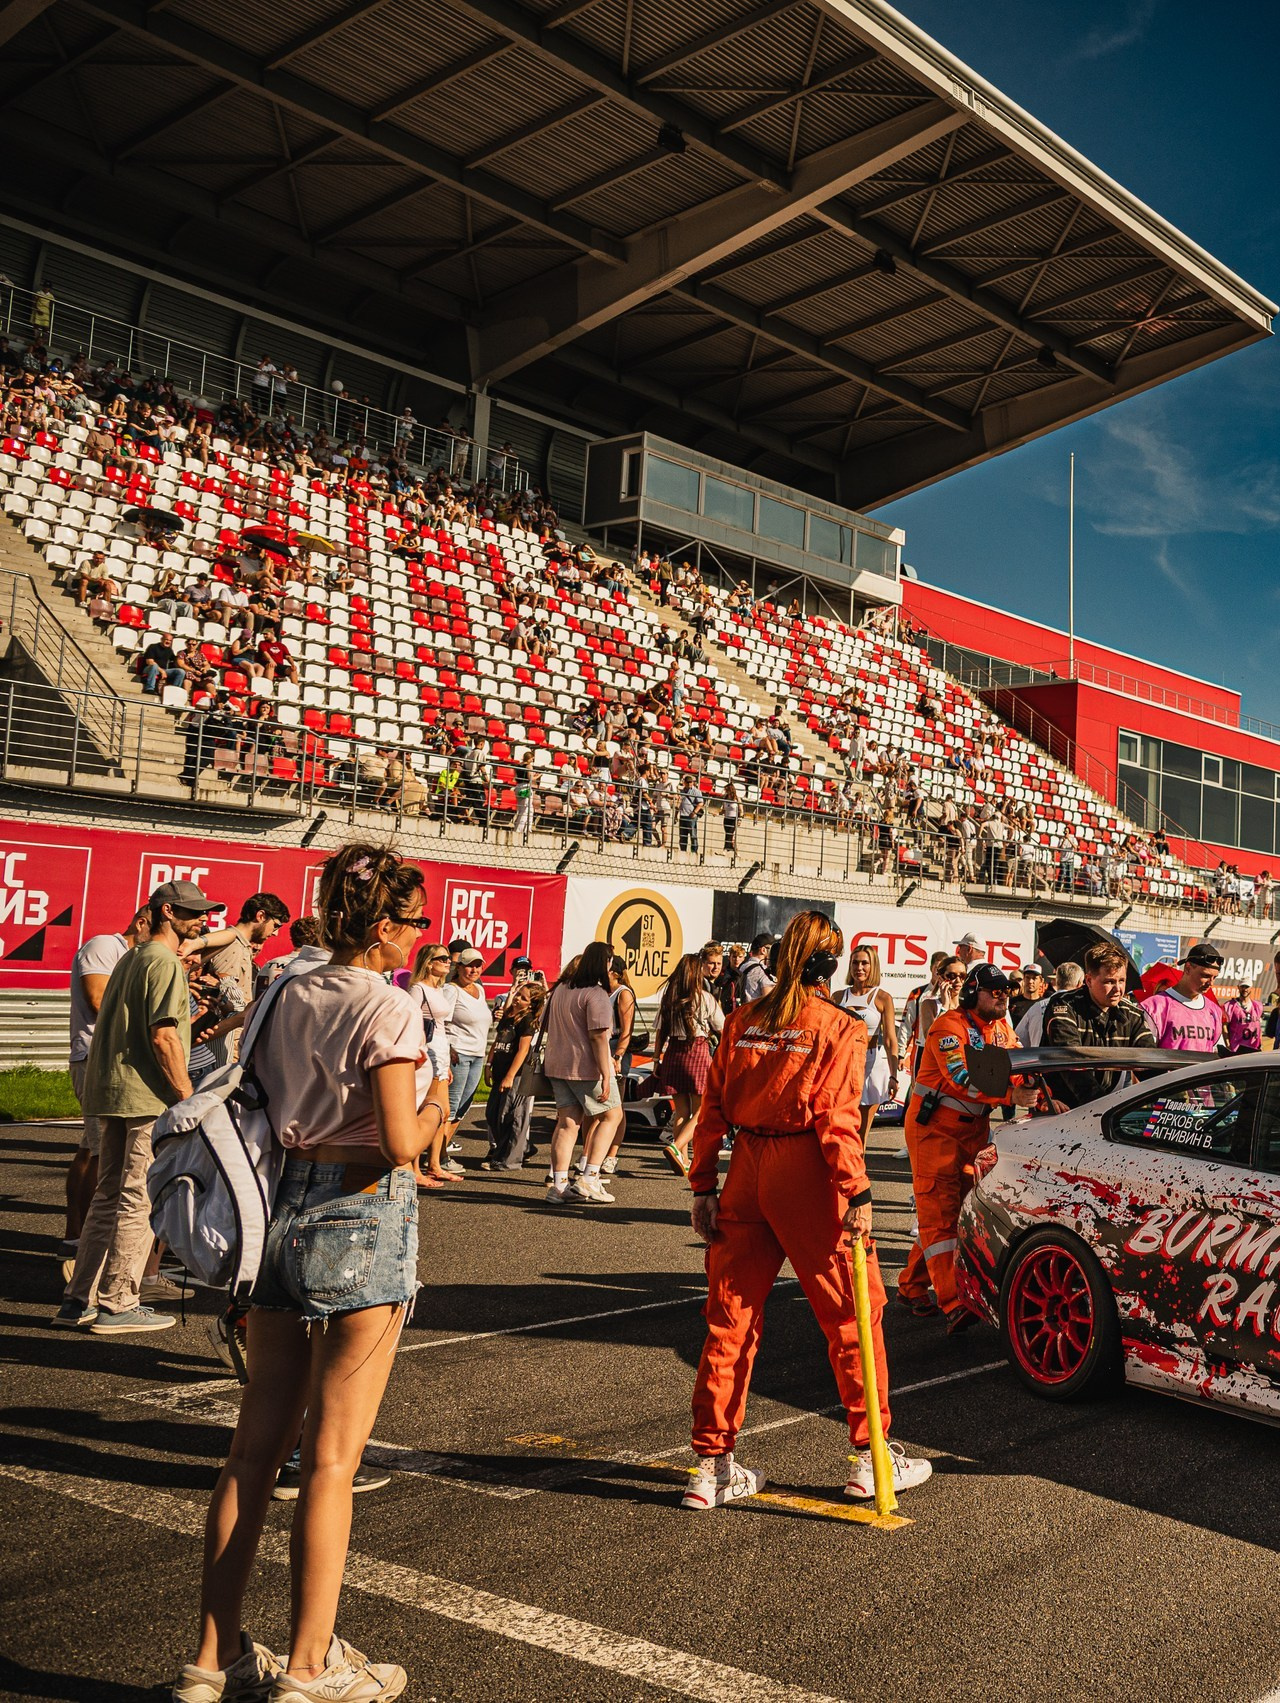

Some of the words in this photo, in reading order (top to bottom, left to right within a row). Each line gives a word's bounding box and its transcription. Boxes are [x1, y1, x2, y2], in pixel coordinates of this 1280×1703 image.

[450, 888, 495, 919] РГС
[448, 917, 509, 949] ЖИЗ
[625, 948, 671, 978] PLACE
[735, 1040, 779, 1052] Marshals
[785, 1044, 812, 1054] Team
[1156, 1112, 1194, 1130] ЯРКОВ
[1194, 1118, 1205, 1132] С.
[1150, 1125, 1203, 1147] АГНИВИН
[1202, 1135, 1213, 1149] В.
